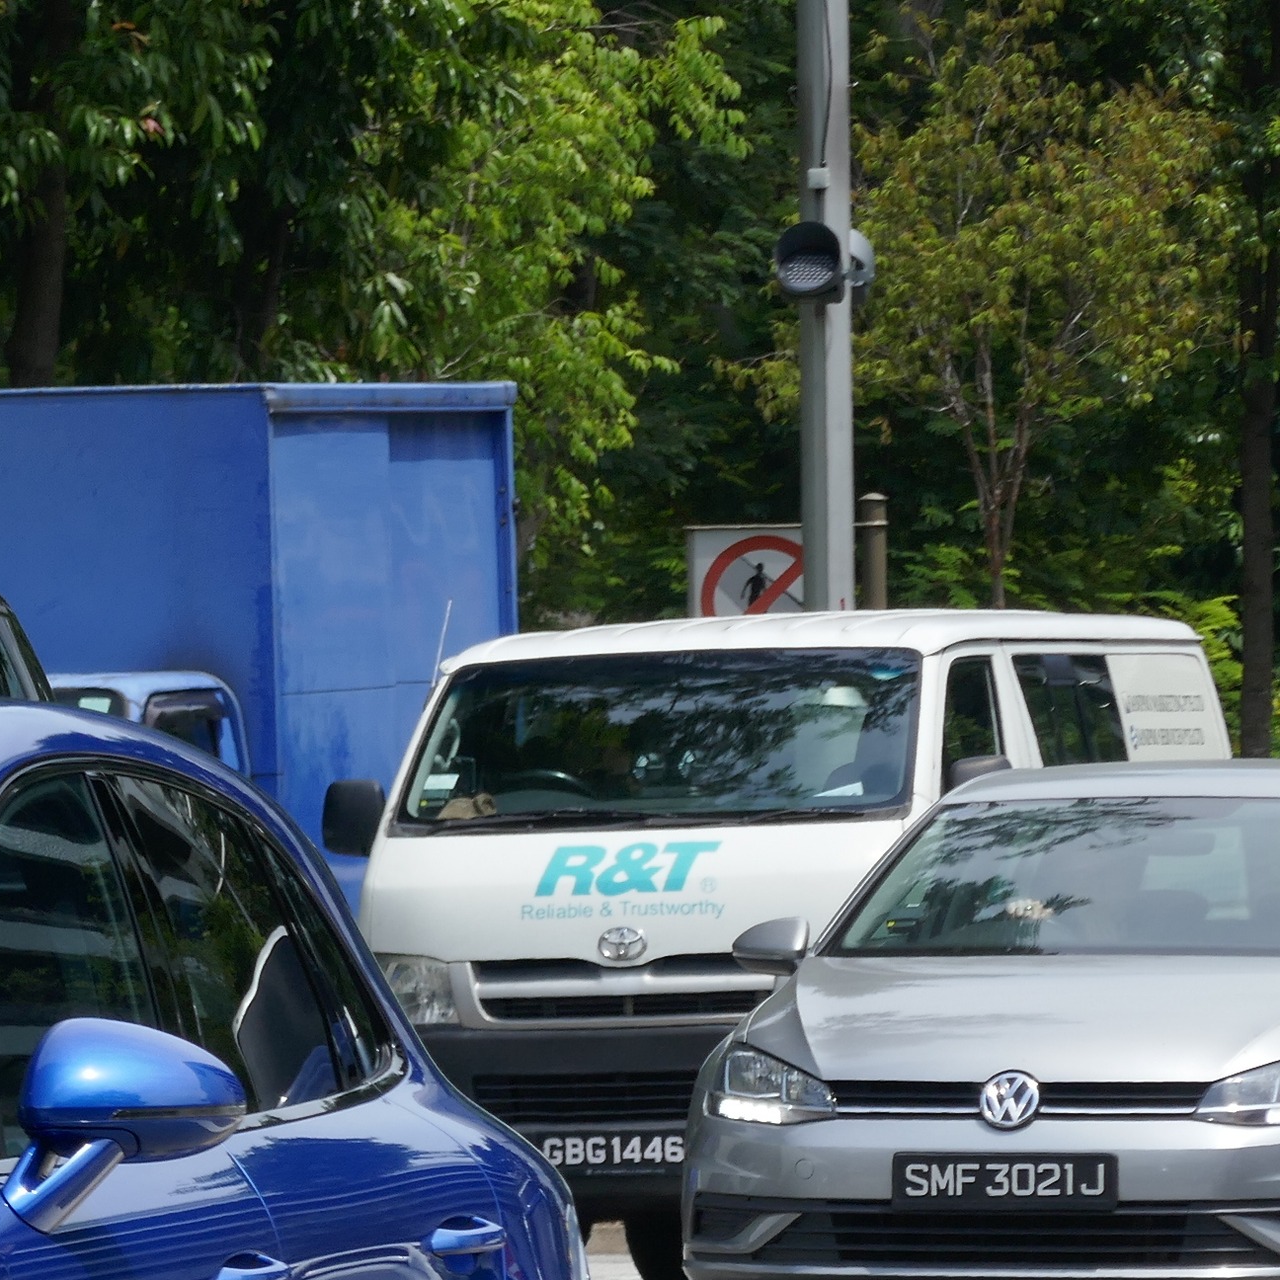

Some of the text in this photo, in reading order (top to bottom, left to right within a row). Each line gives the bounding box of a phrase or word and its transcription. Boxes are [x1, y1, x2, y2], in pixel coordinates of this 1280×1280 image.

[534, 840, 723, 897] R&T
[520, 899, 726, 921] Reliable & Trustworthy
[905, 1163, 980, 1197] SMF
